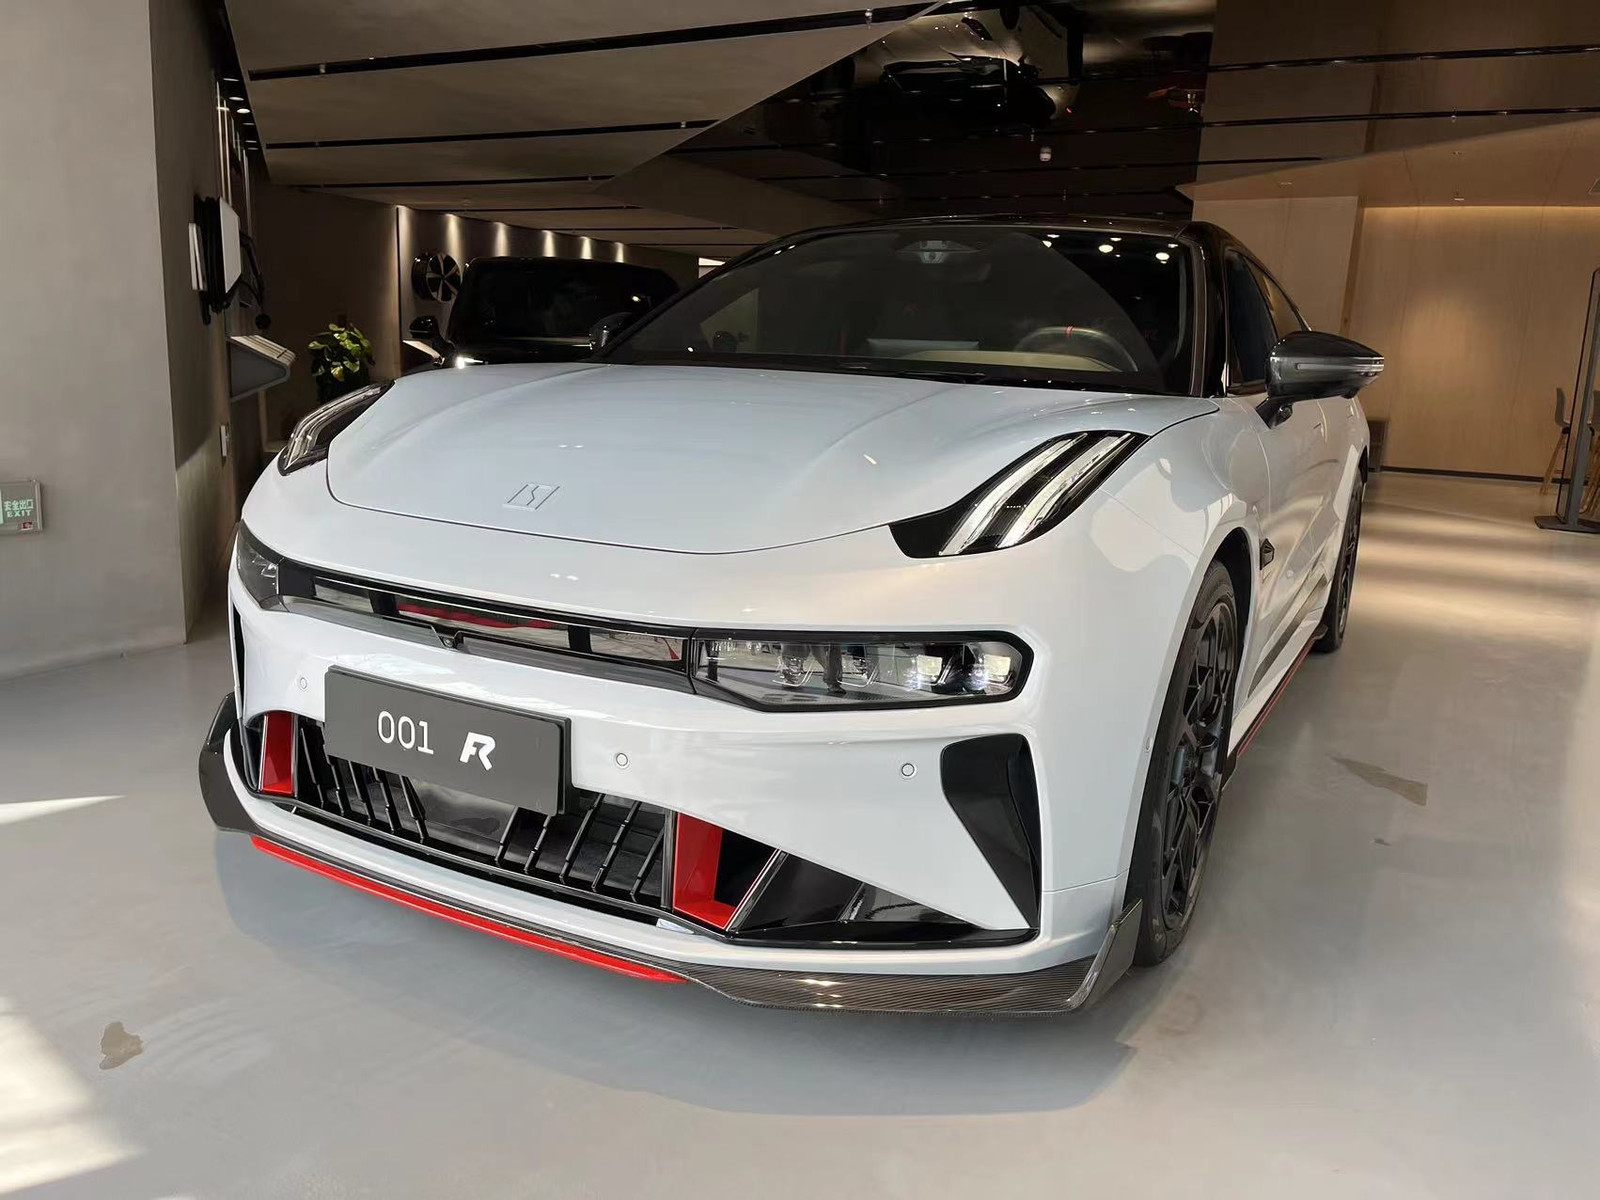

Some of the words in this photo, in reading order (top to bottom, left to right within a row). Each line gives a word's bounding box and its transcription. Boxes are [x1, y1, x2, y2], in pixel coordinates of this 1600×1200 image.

[7, 509, 31, 517] EXIT
[378, 710, 434, 755] 001
[459, 731, 496, 771] R
